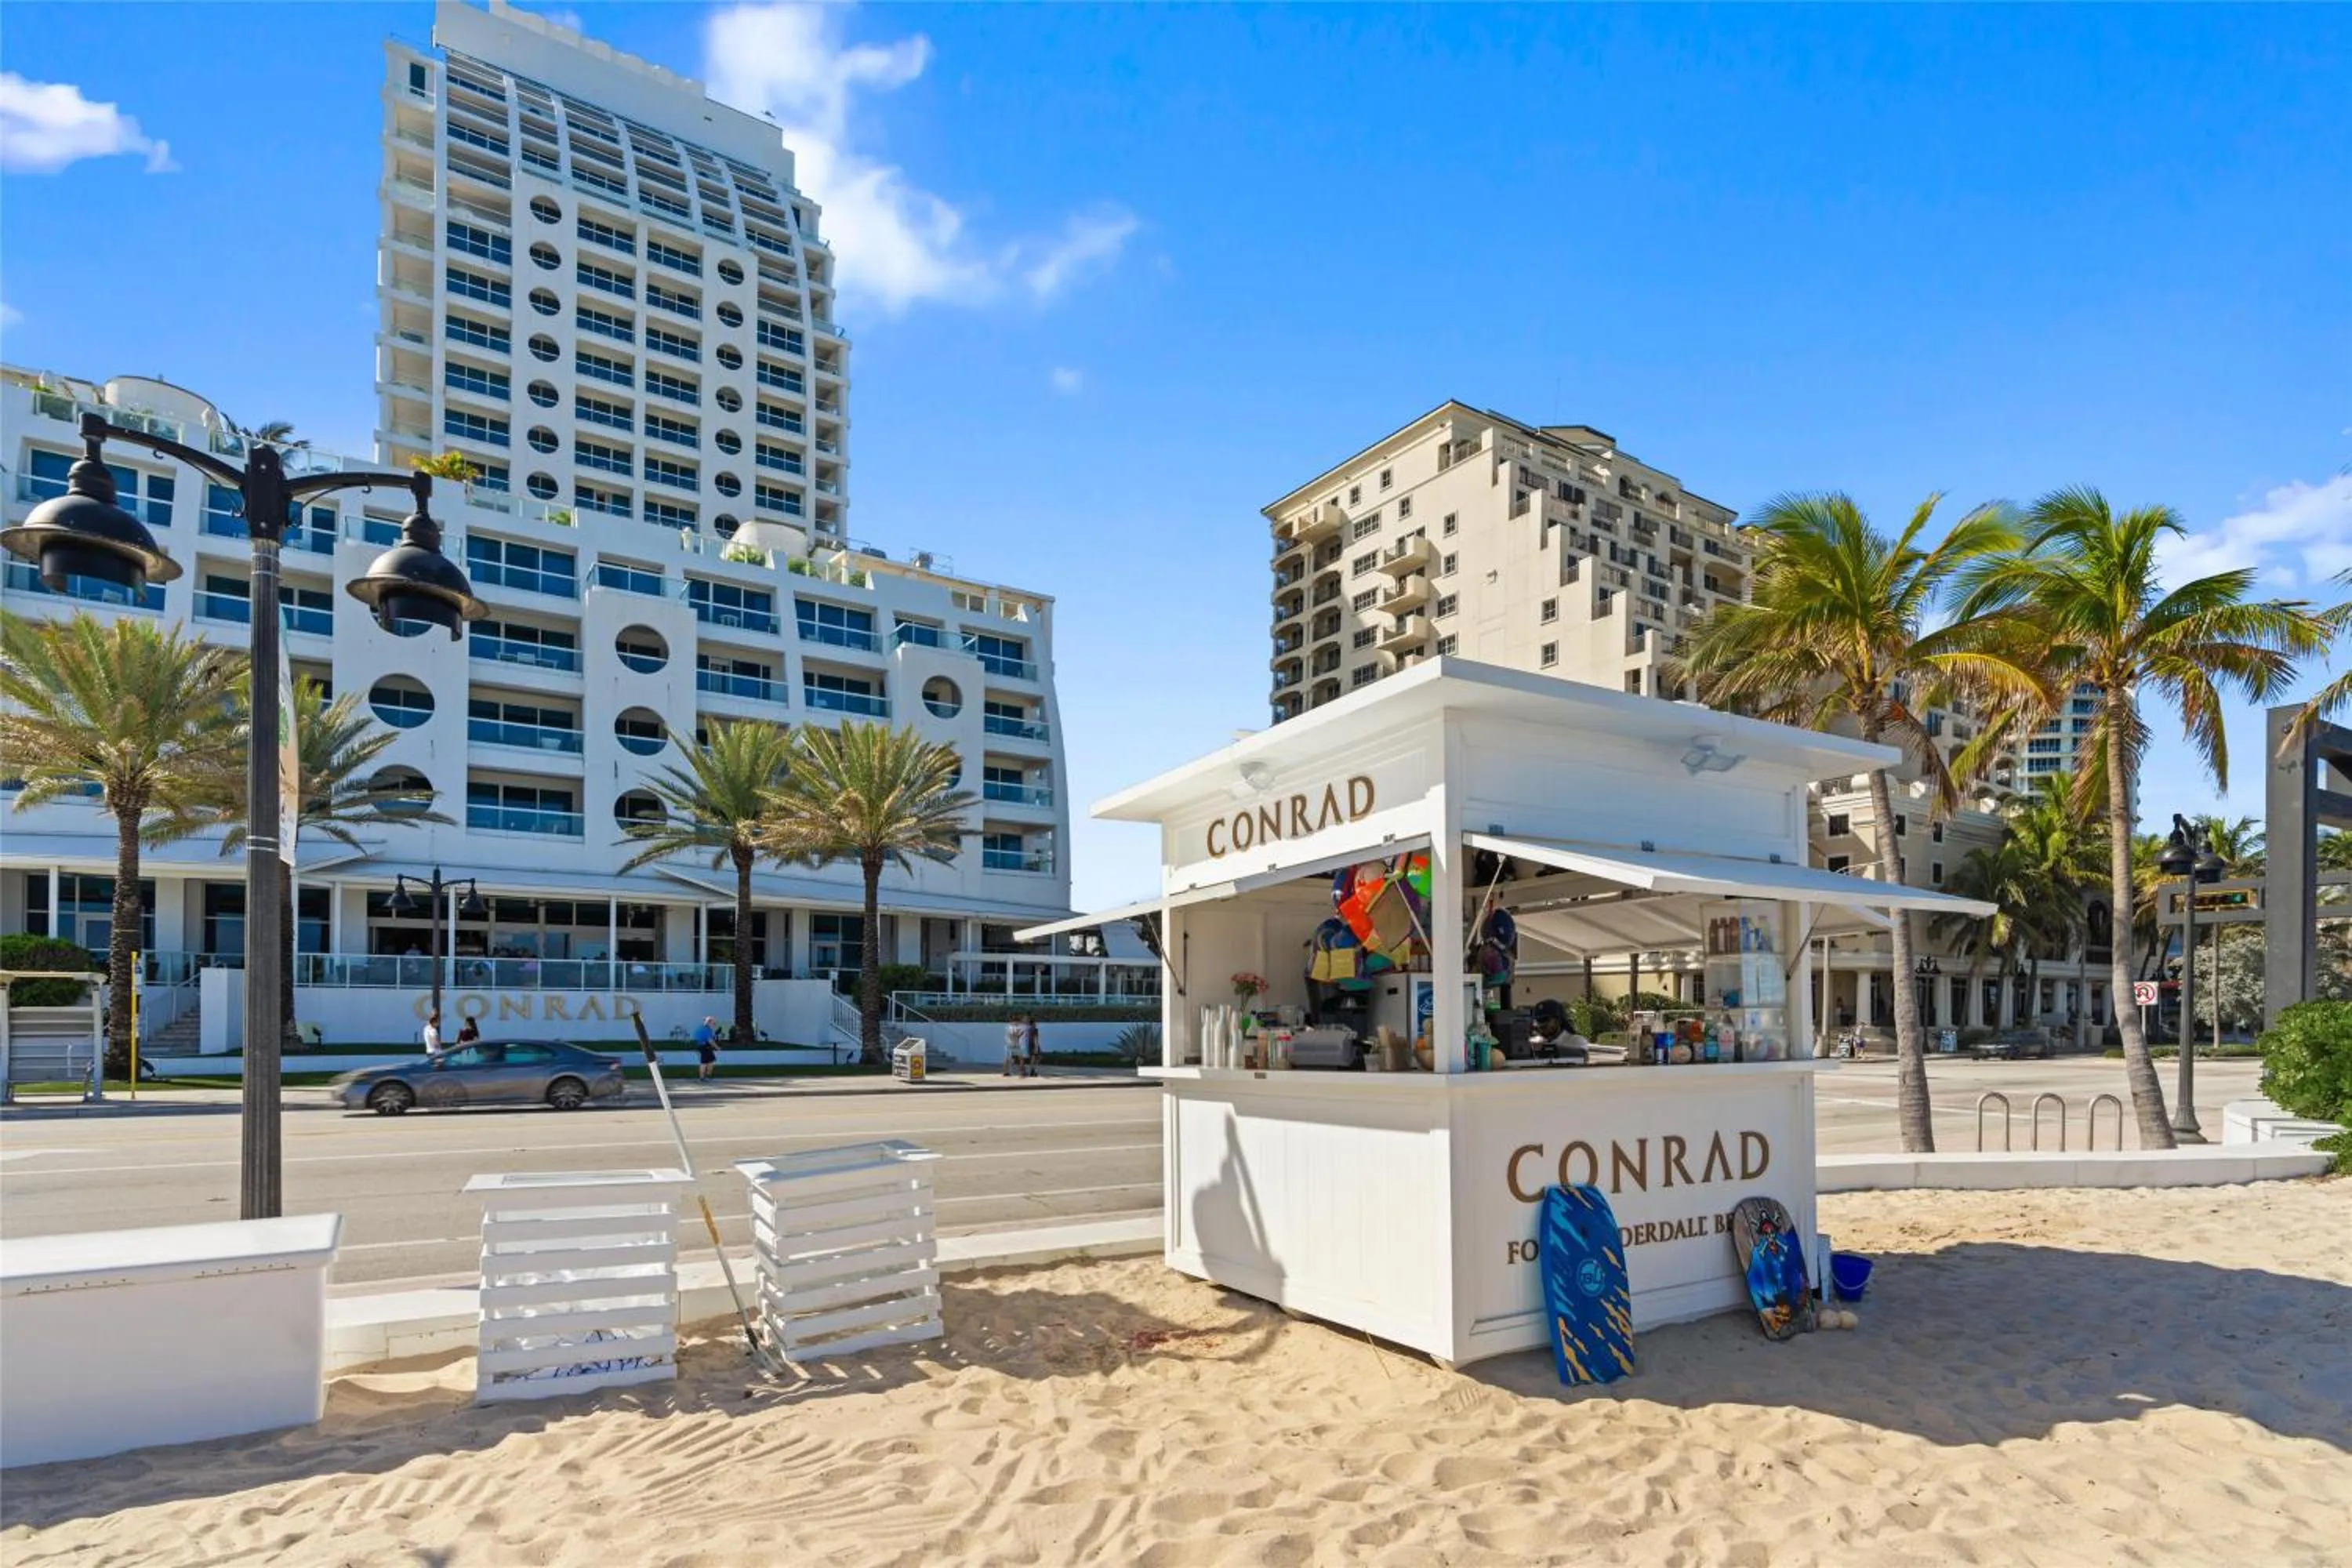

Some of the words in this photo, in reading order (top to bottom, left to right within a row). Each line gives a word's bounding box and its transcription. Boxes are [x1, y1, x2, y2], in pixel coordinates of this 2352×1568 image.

[1207, 775, 1374, 858] CONRAD
[413, 993, 642, 1022] CONRAD
[1507, 1130, 1769, 1203] CONRAD
[1507, 1239, 1539, 1265] FO
